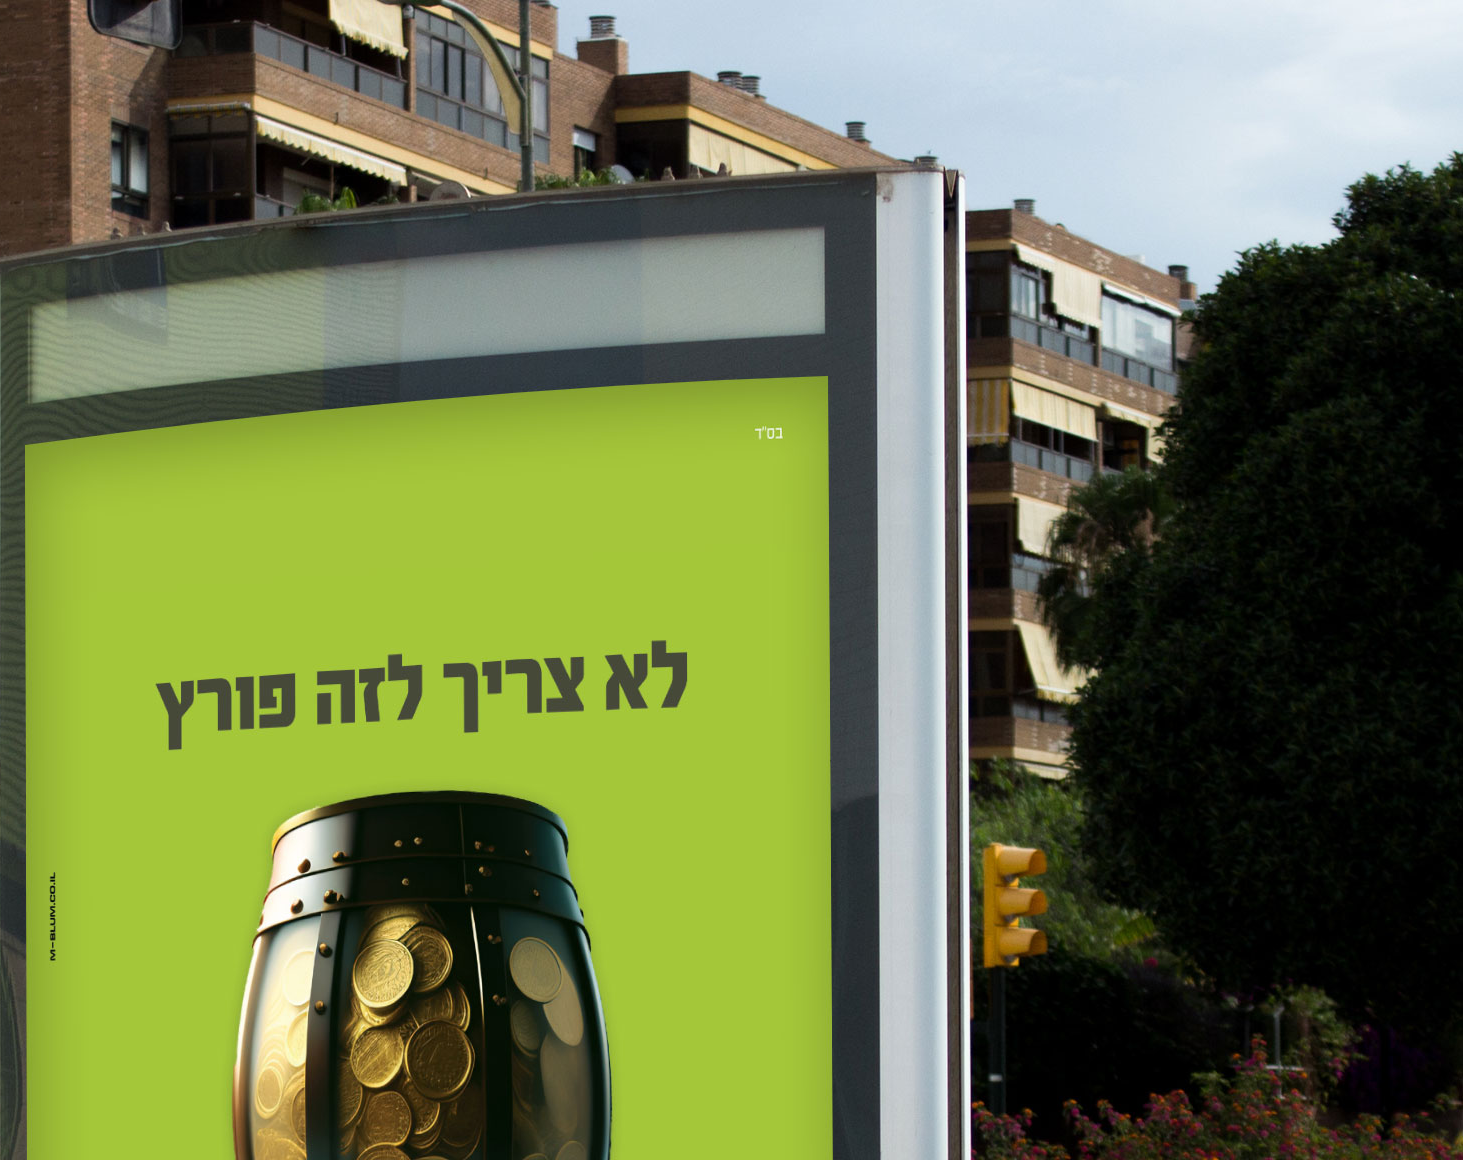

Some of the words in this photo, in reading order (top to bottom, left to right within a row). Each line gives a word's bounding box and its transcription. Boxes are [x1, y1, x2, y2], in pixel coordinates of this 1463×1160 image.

[754, 426, 784, 440] בס"ד
[155, 672, 296, 751] פורץ
[316, 653, 423, 726] לזה
[442, 656, 585, 734] צריך
[604, 639, 688, 711] לא
[49, 871, 57, 962] M-BLUM.CO.IL
